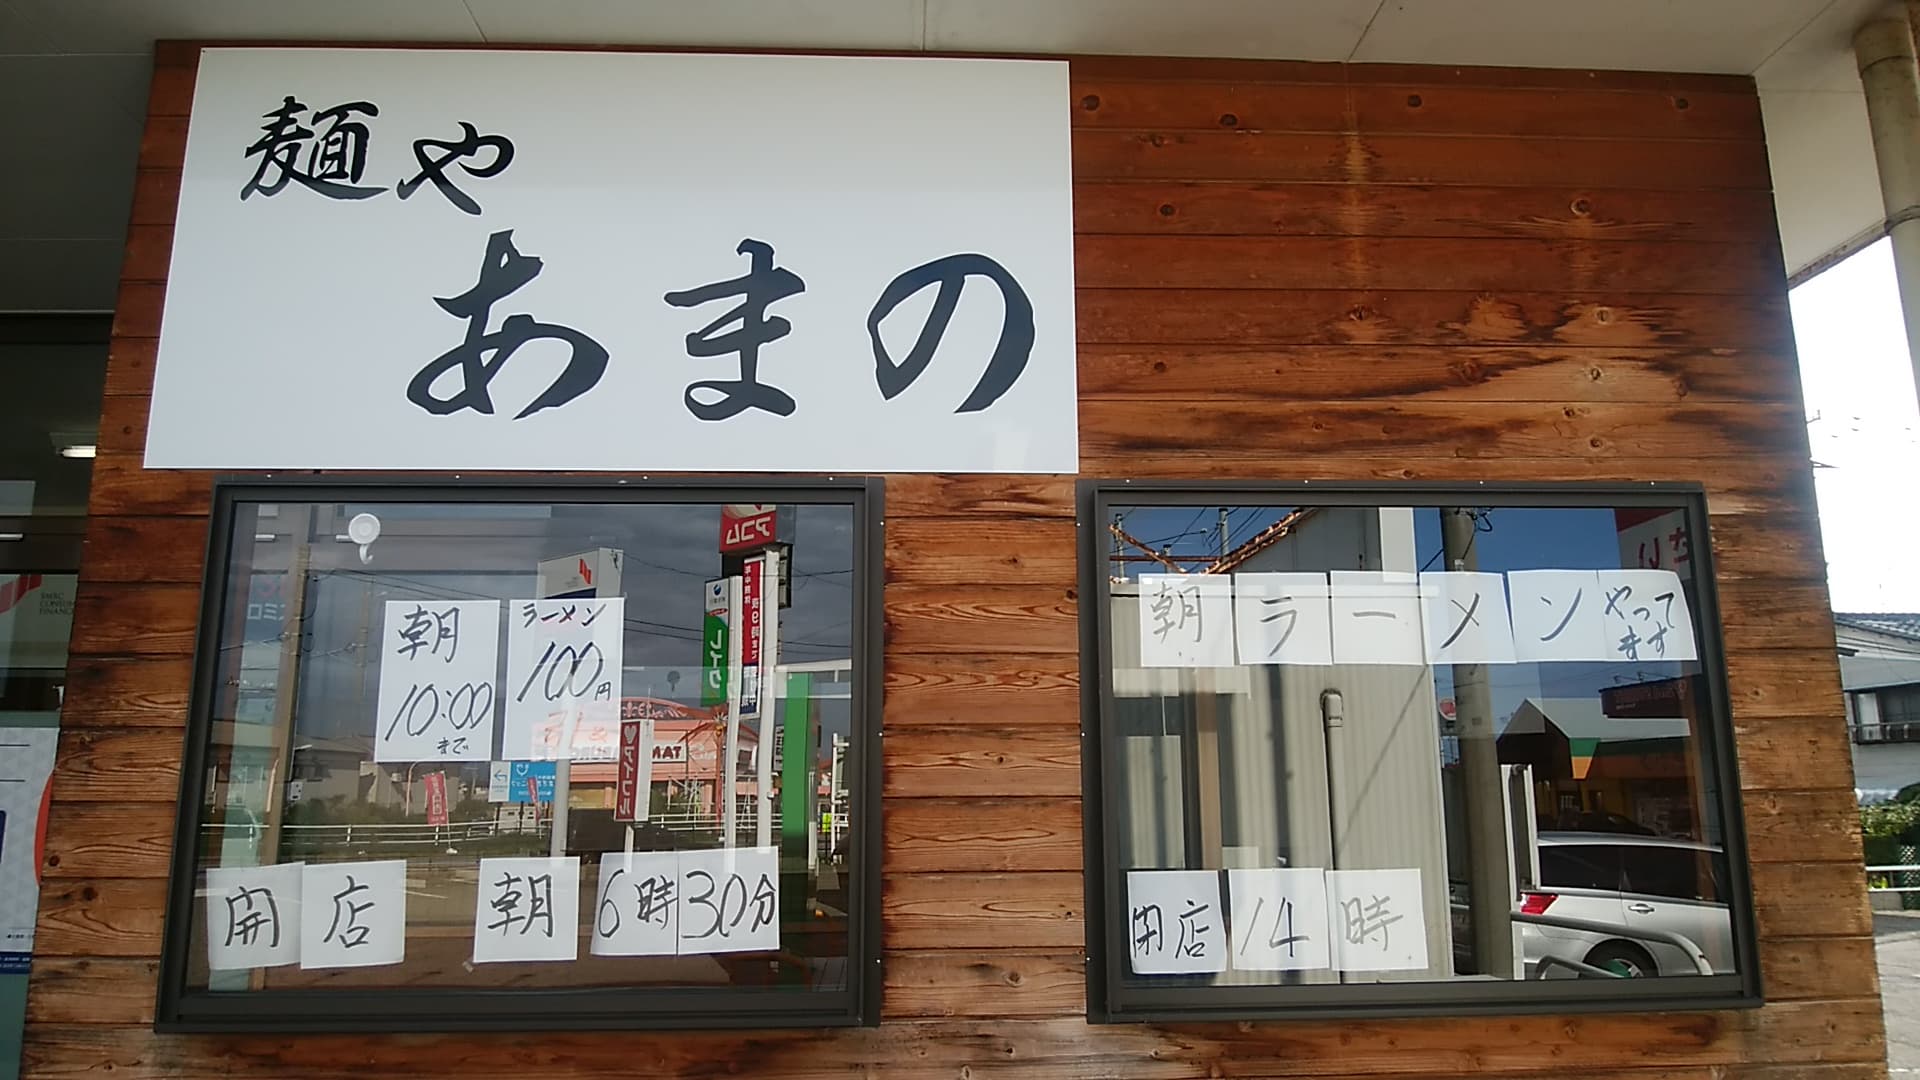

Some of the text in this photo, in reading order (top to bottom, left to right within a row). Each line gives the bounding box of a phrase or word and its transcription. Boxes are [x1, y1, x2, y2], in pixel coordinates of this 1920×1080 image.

[407, 229, 1035, 421] あまの
[397, 603, 461, 664] 朝
[523, 600, 607, 628] ラーメン
[1151, 583, 1583, 657] 朝ラーメン
[1605, 585, 1676, 628] やって
[1618, 621, 1669, 660] ます
[516, 641, 612, 703] 100円
[385, 682, 494, 743] 10:00
[437, 738, 469, 755] まで
[225, 868, 778, 949] 開店 朝 6時30分
